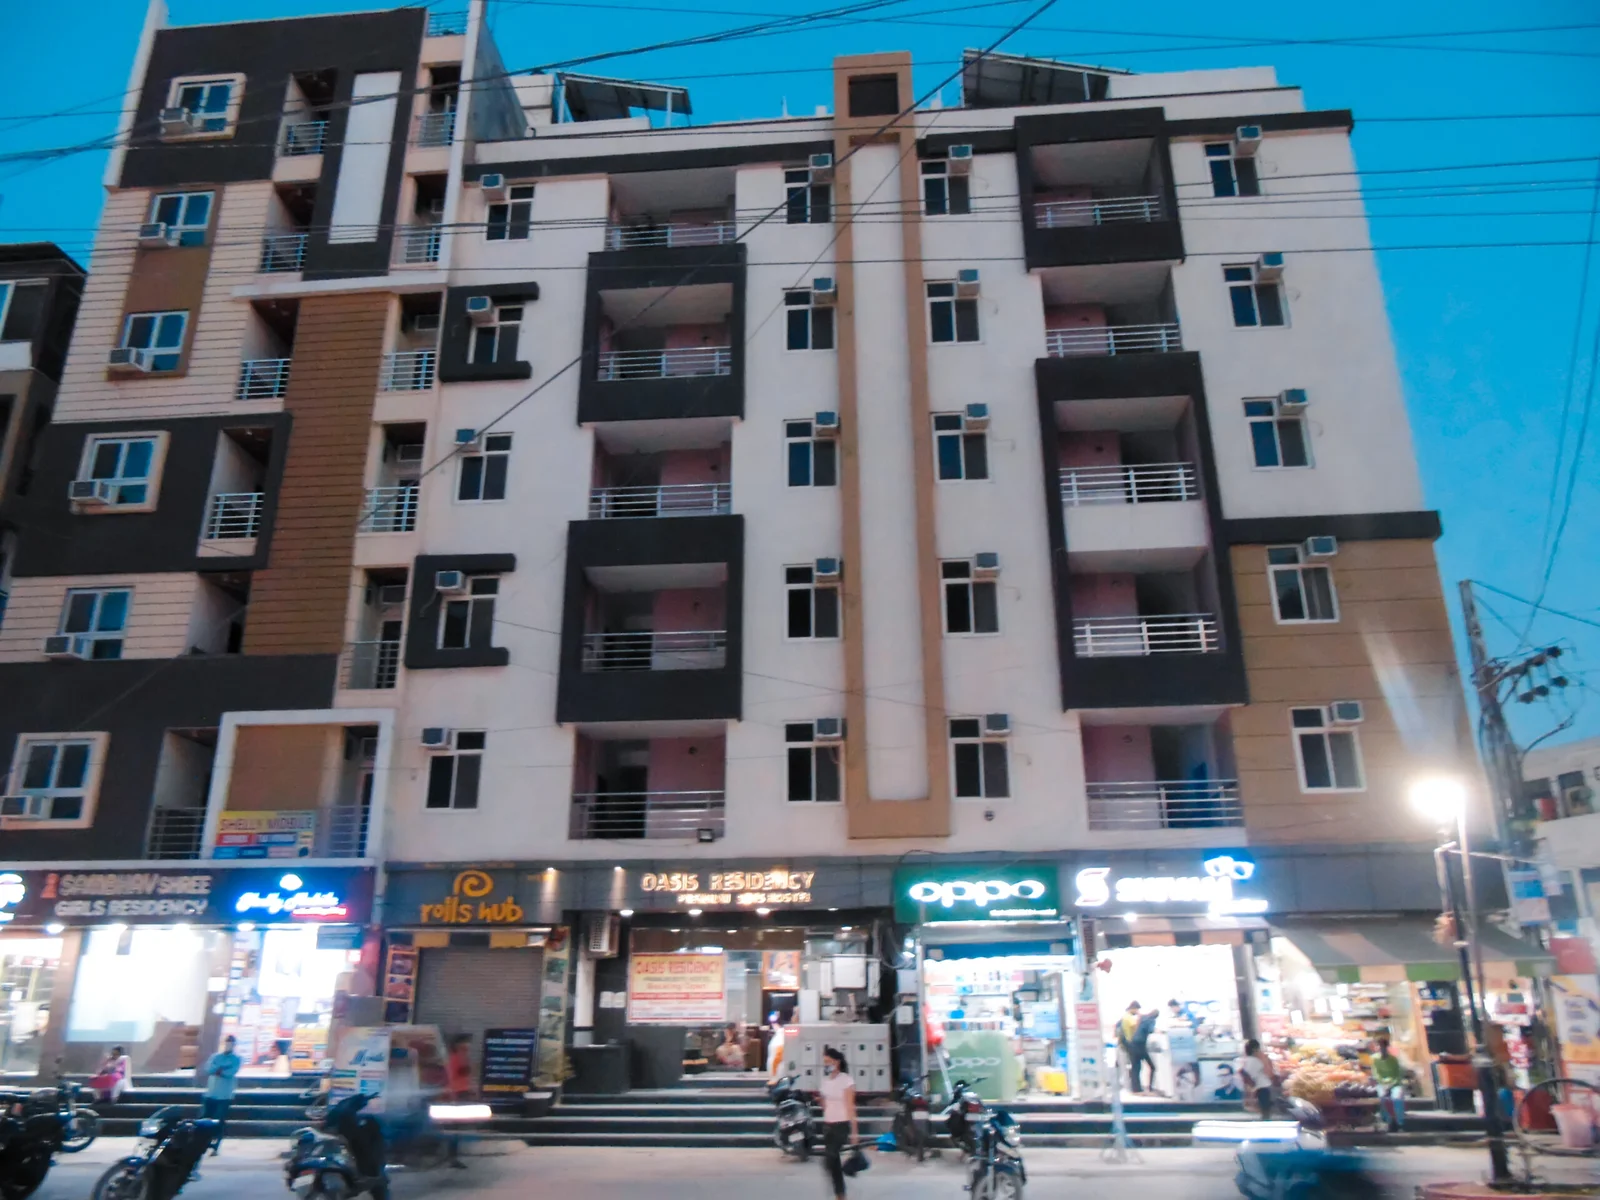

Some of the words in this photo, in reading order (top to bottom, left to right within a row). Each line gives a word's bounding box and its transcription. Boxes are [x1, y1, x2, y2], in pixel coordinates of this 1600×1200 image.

[640, 872, 699, 891] OASIS
[709, 870, 816, 890] RESIDENCY
[54, 900, 107, 917] GIRLS
[107, 899, 209, 916] RESIDENCY
[420, 895, 474, 923] rolls
[477, 895, 524, 922] hub
